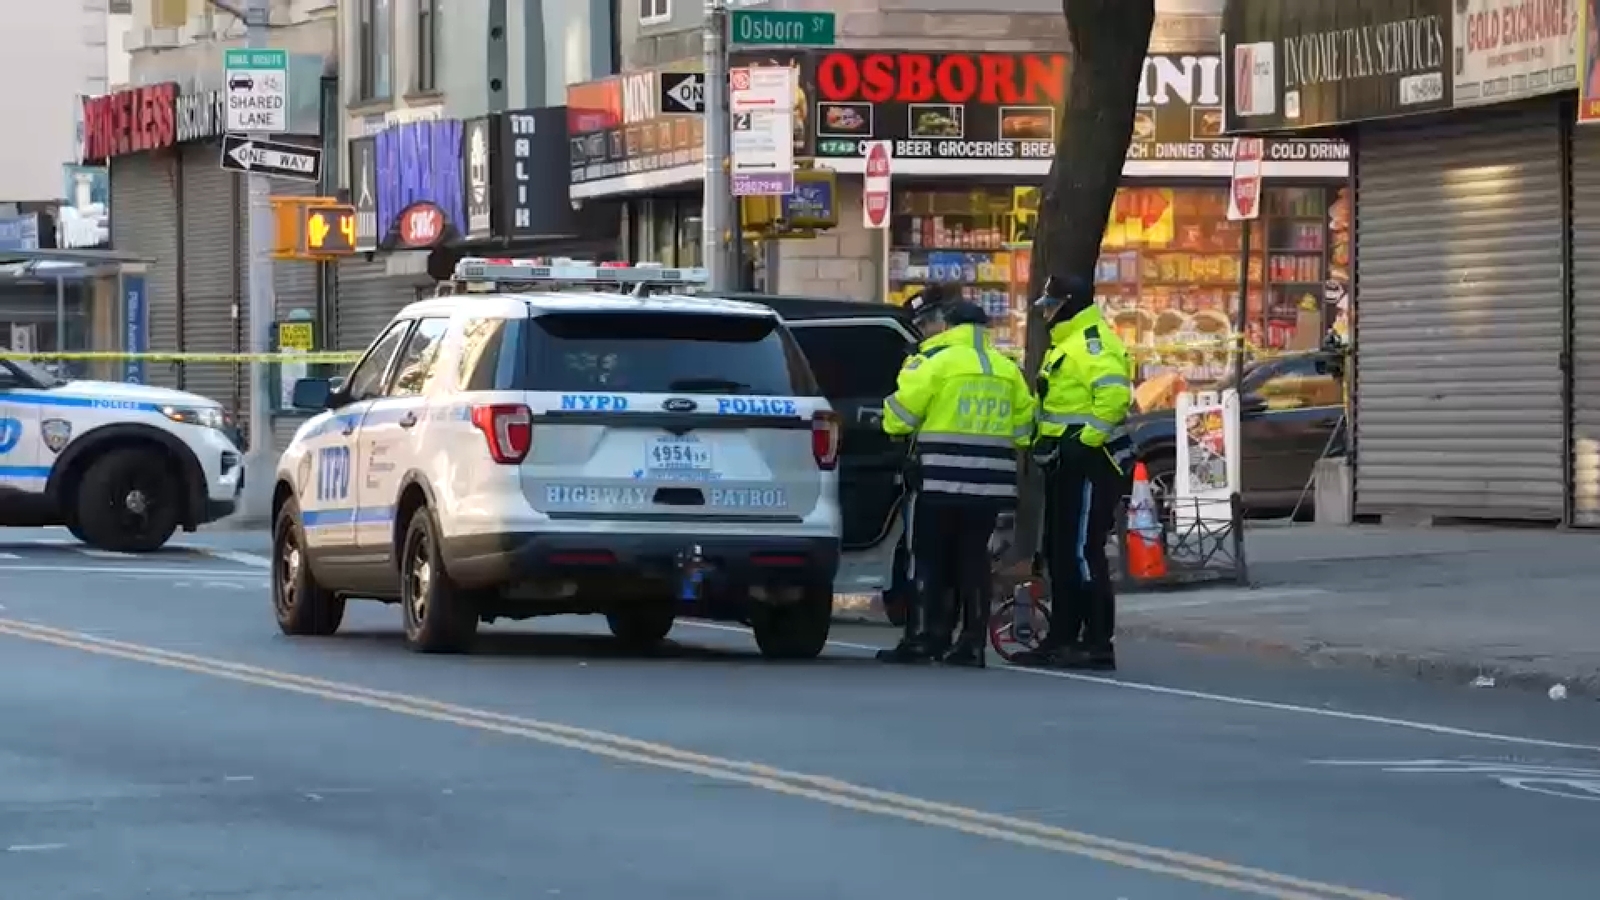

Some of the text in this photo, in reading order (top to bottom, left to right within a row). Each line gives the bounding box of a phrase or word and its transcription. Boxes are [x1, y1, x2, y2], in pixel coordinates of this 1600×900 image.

[741, 14, 804, 41] Osborn
[1467, 0, 1568, 52] GOLD EXCHANGE
[1284, 14, 1444, 87] INCOME TAX SERVICES
[817, 53, 1220, 105] OSBORN INI
[230, 95, 283, 109] SHARED
[680, 84, 704, 101] ON
[83, 82, 175, 161] PRICELESS
[239, 112, 275, 125] LANE
[238, 148, 308, 170] ONE WAY
[896, 140, 931, 156] BEER
[938, 141, 1014, 157] GROCERIES
[1021, 142, 1055, 157] BREA
[1156, 142, 1205, 159] DINNER
[1271, 143, 1306, 160] COLD
[340, 215, 355, 246] 4
[96, 400, 136, 410] POLICE
[561, 394, 628, 411] NYPD
[716, 398, 796, 415] POLICE
[958, 397, 1010, 418] NYPD
[652, 446, 693, 462] 4954
[546, 485, 787, 506] HIGHWAY PATROL
